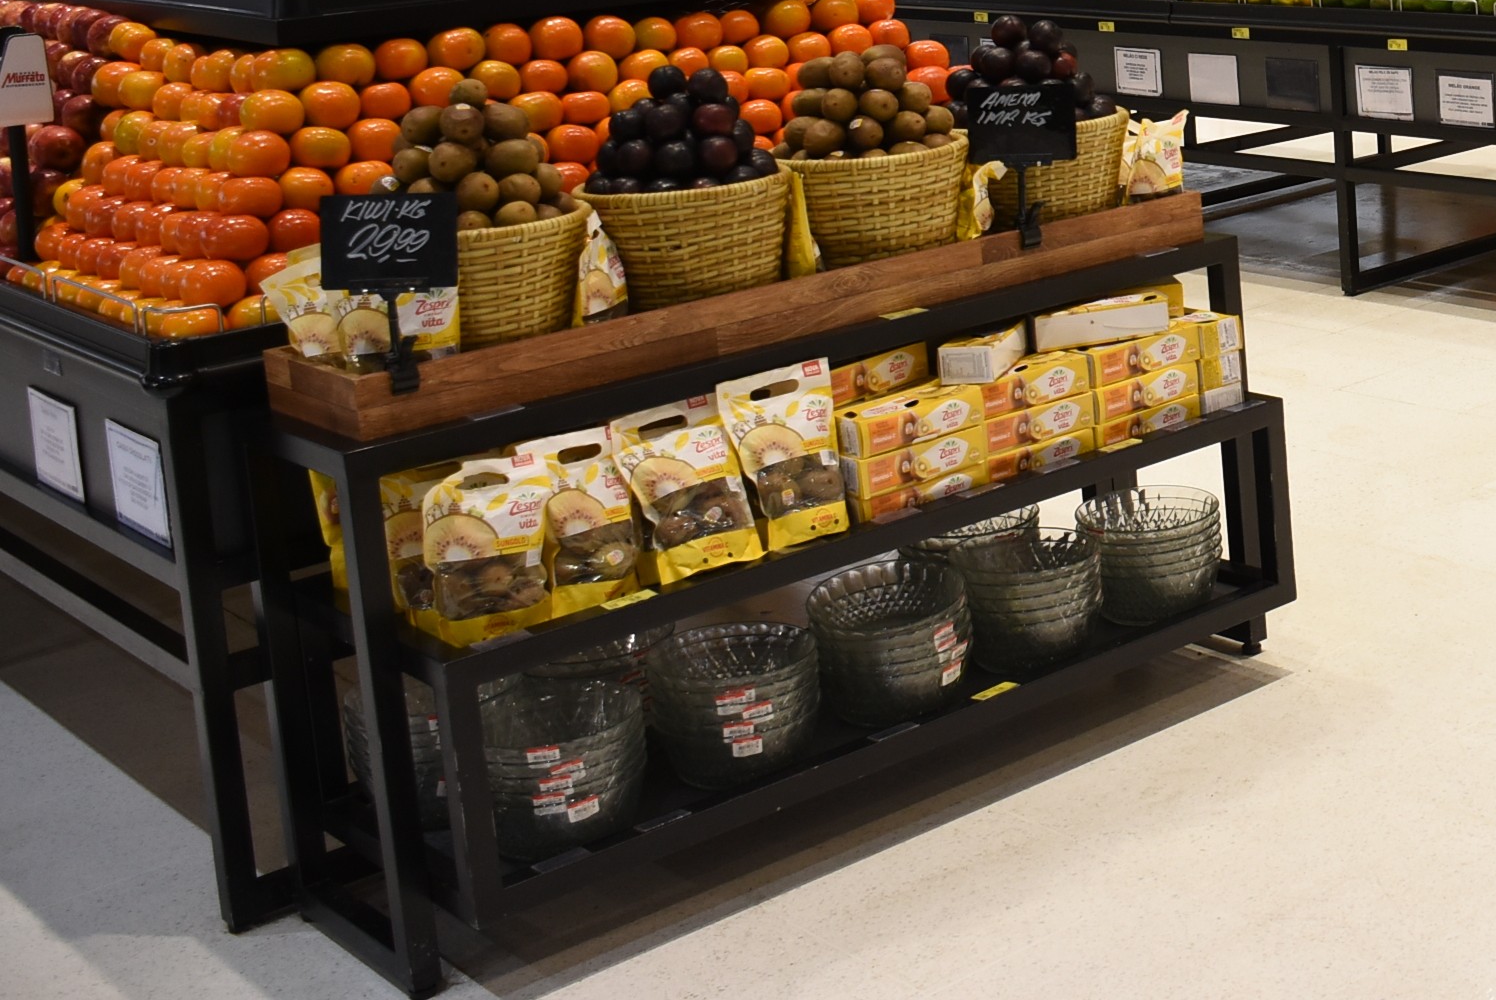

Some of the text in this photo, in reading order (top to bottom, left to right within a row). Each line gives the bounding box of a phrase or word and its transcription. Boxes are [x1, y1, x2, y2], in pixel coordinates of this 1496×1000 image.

[1, 71, 45, 89] Muffato
[346, 223, 431, 264] 29,99
[421, 317, 445, 328] vita
[519, 518, 539, 530] vita
[496, 535, 527, 549] SUNGOLD
